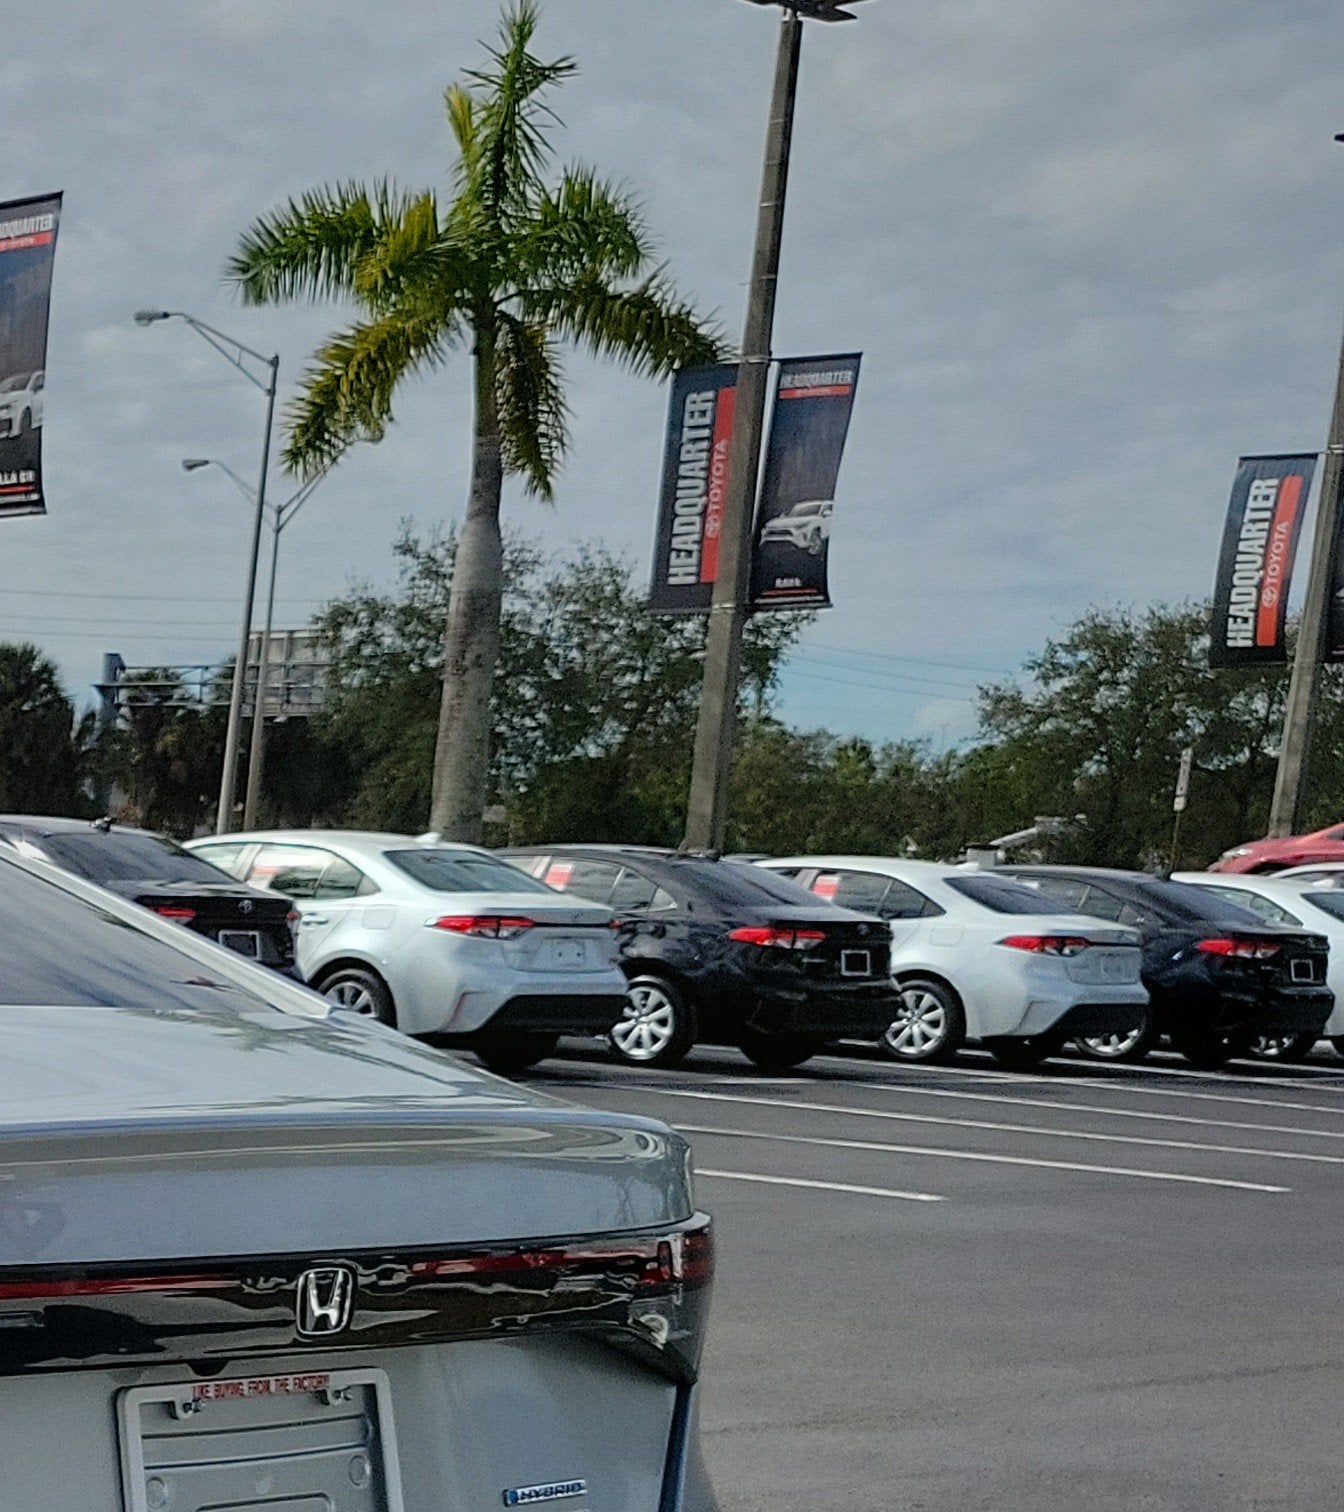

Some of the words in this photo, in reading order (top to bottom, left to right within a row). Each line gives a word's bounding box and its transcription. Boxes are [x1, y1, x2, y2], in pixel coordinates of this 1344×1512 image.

[667, 389, 716, 586] HEADQUARTER
[708, 438, 729, 512] TOYOTA
[1226, 477, 1280, 648] HEADQUARTER
[1265, 521, 1290, 584] TOYOTA
[248, 1379, 271, 1394] FROM
[274, 1378, 290, 1393] THE
[519, 1482, 583, 1500] HYBRID
